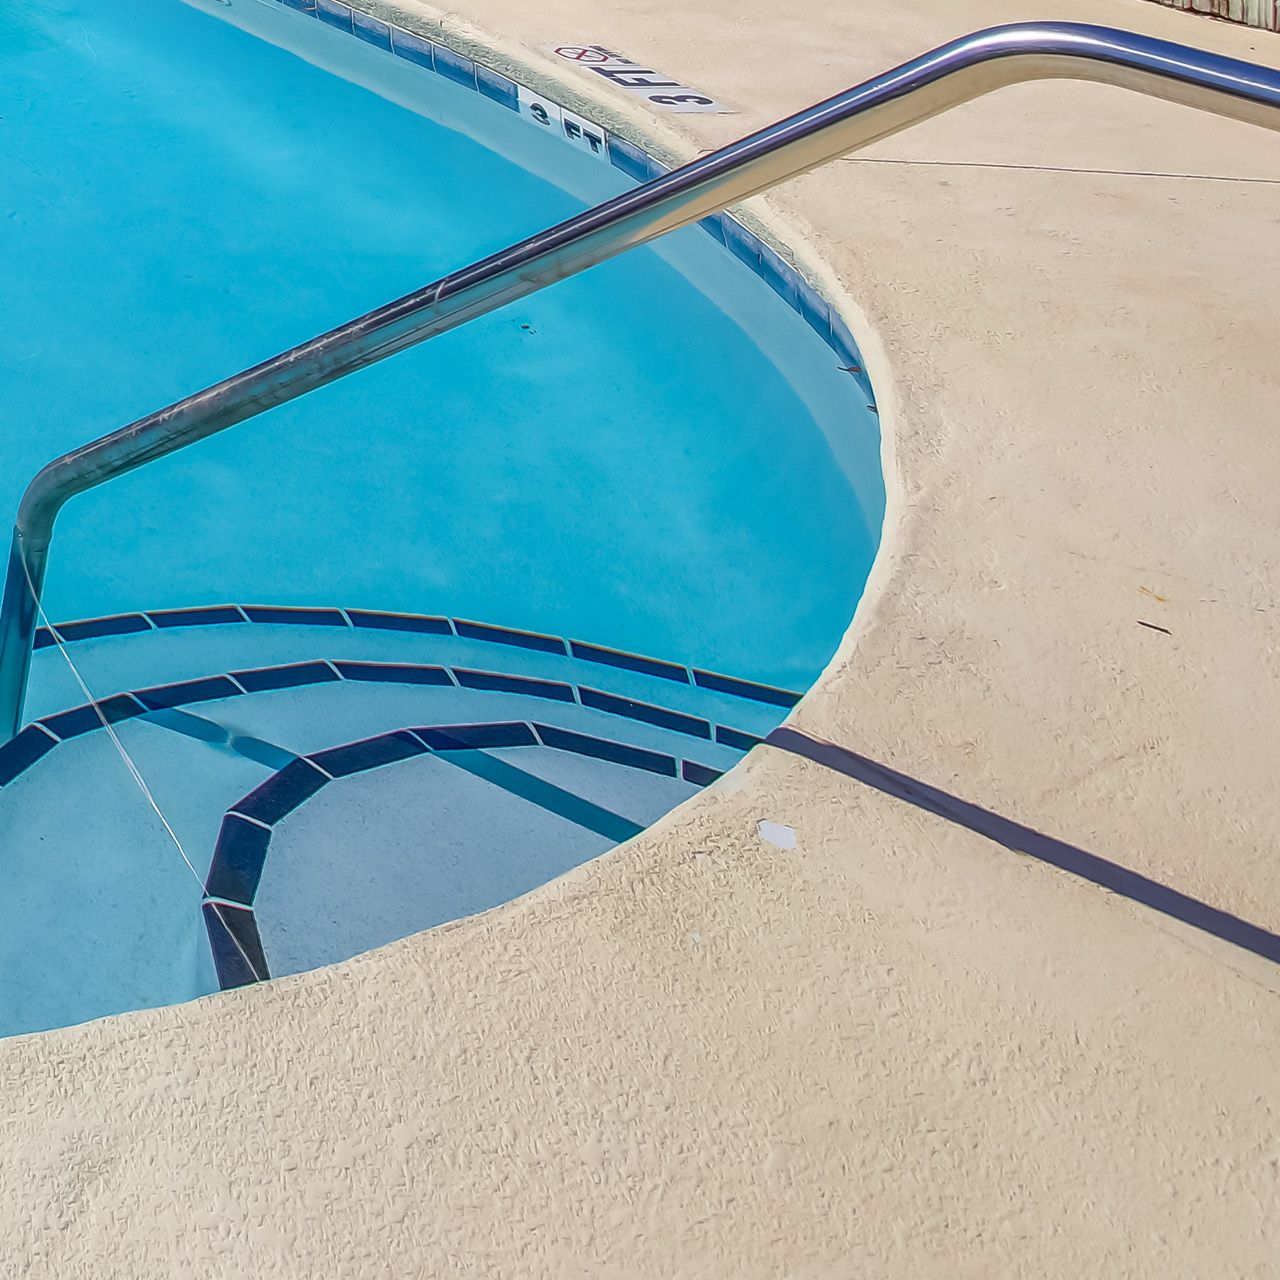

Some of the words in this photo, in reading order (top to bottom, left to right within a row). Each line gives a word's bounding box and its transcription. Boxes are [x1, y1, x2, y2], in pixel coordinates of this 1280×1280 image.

[588, 65, 682, 88] FT
[648, 94, 714, 106] 3
[529, 102, 551, 126] 3
[564, 118, 603, 154] FT
